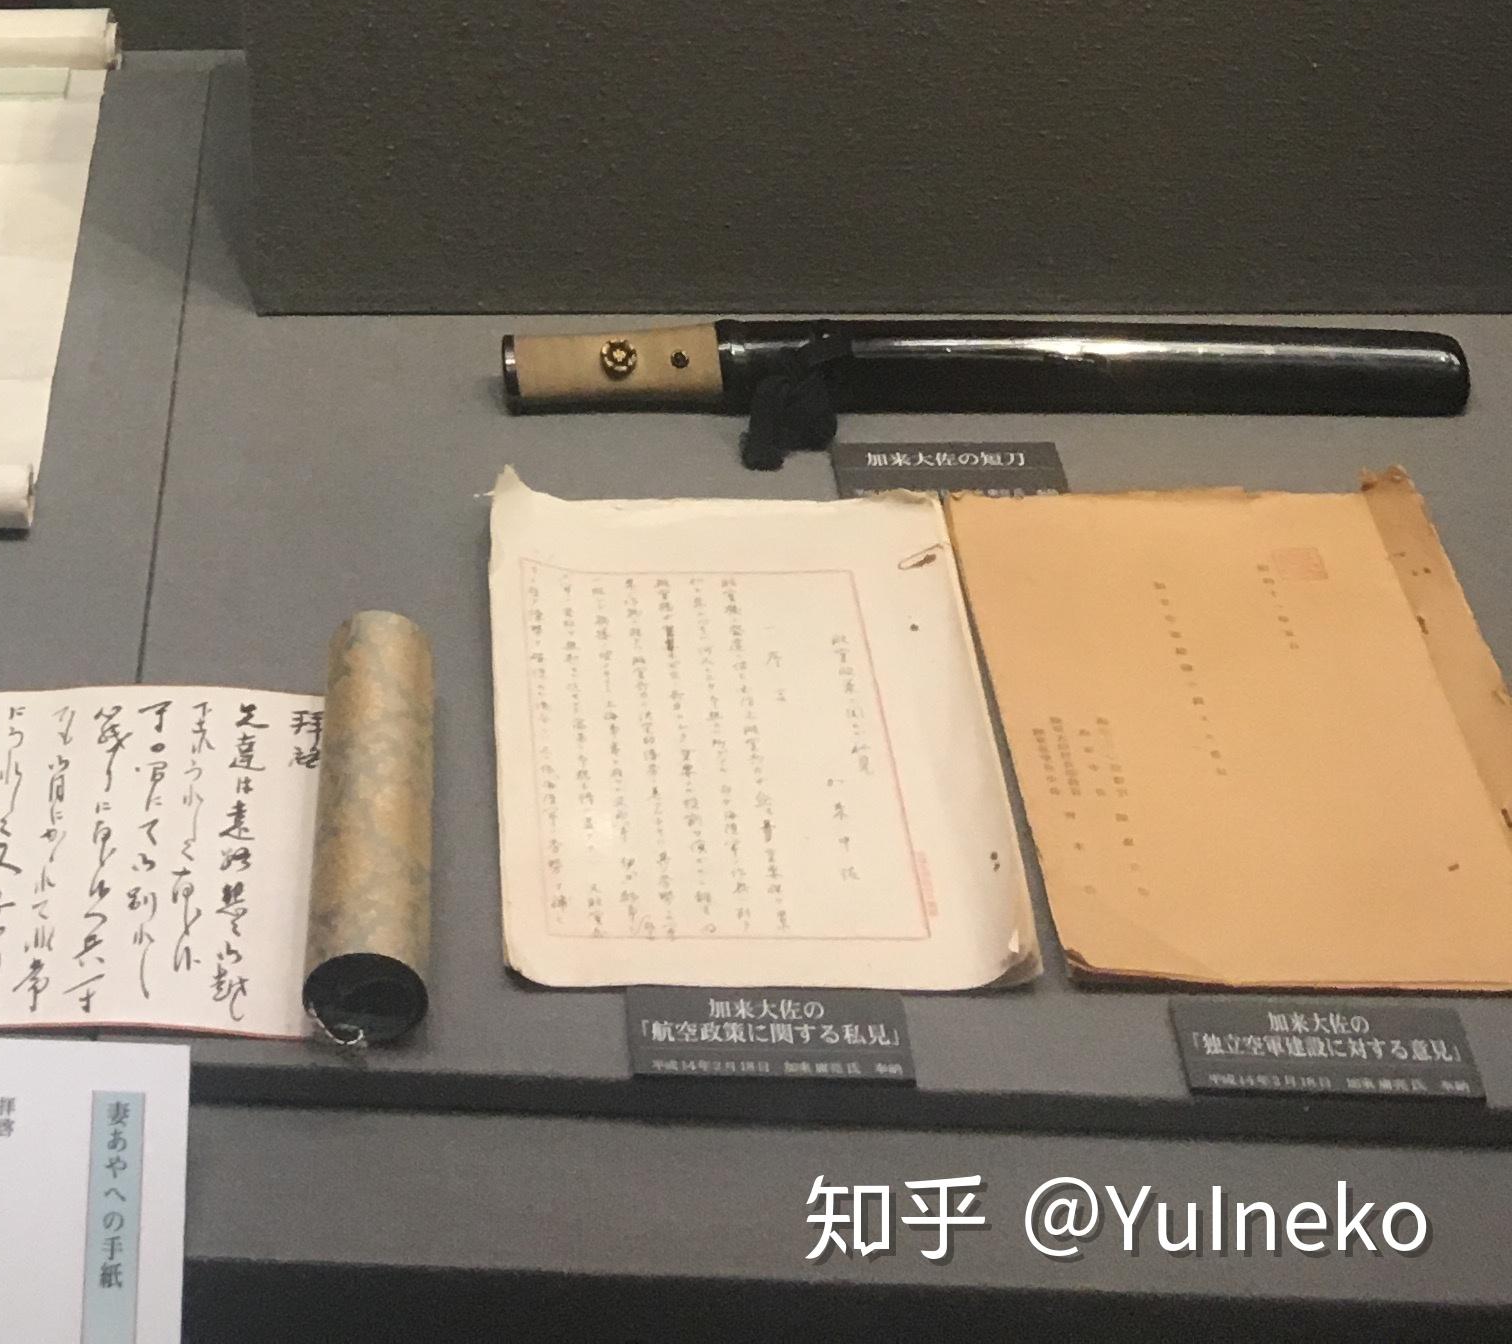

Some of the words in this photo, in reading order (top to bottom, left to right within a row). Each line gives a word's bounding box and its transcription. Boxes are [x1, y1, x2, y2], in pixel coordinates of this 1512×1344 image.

[98, 1099, 132, 1290] 妻あやへの手紙
